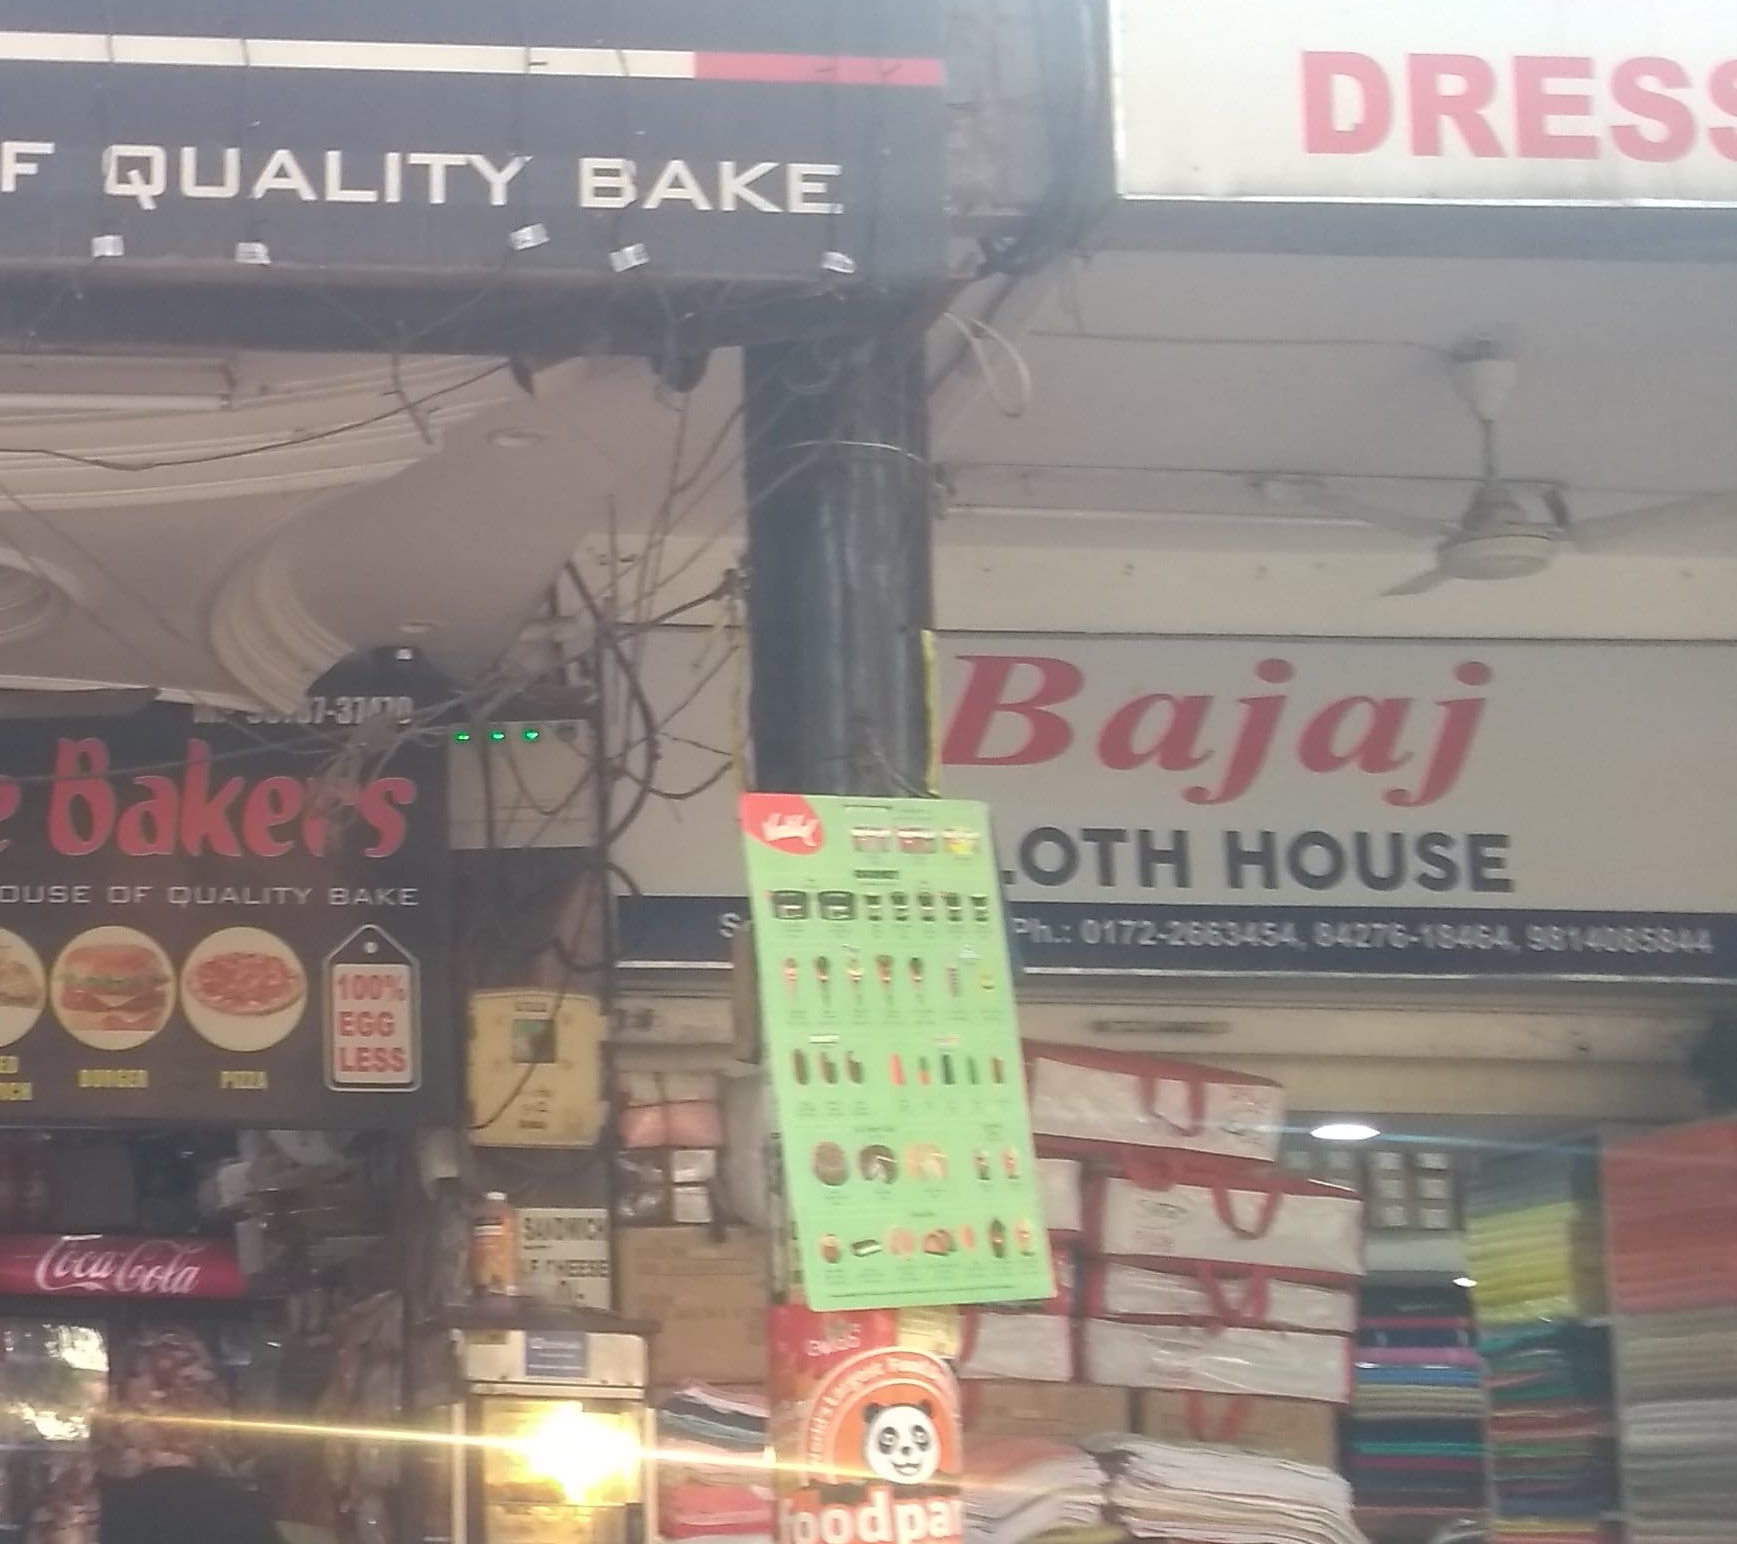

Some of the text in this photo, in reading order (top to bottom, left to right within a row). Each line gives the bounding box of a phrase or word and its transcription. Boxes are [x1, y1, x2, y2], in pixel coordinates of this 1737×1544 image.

[101, 142, 528, 211] QUALITY
[577, 154, 844, 216] BAKE
[940, 654, 1493, 808] Bajaj
[48, 737, 417, 858] Bakers
[1223, 828, 1516, 894] HOUSE
[106, 885, 153, 906] OF
[166, 885, 314, 910] QUALITY
[328, 887, 420, 908] BAKE
[337, 1010, 394, 1037] EGG
[337, 1046, 406, 1072] LESS
